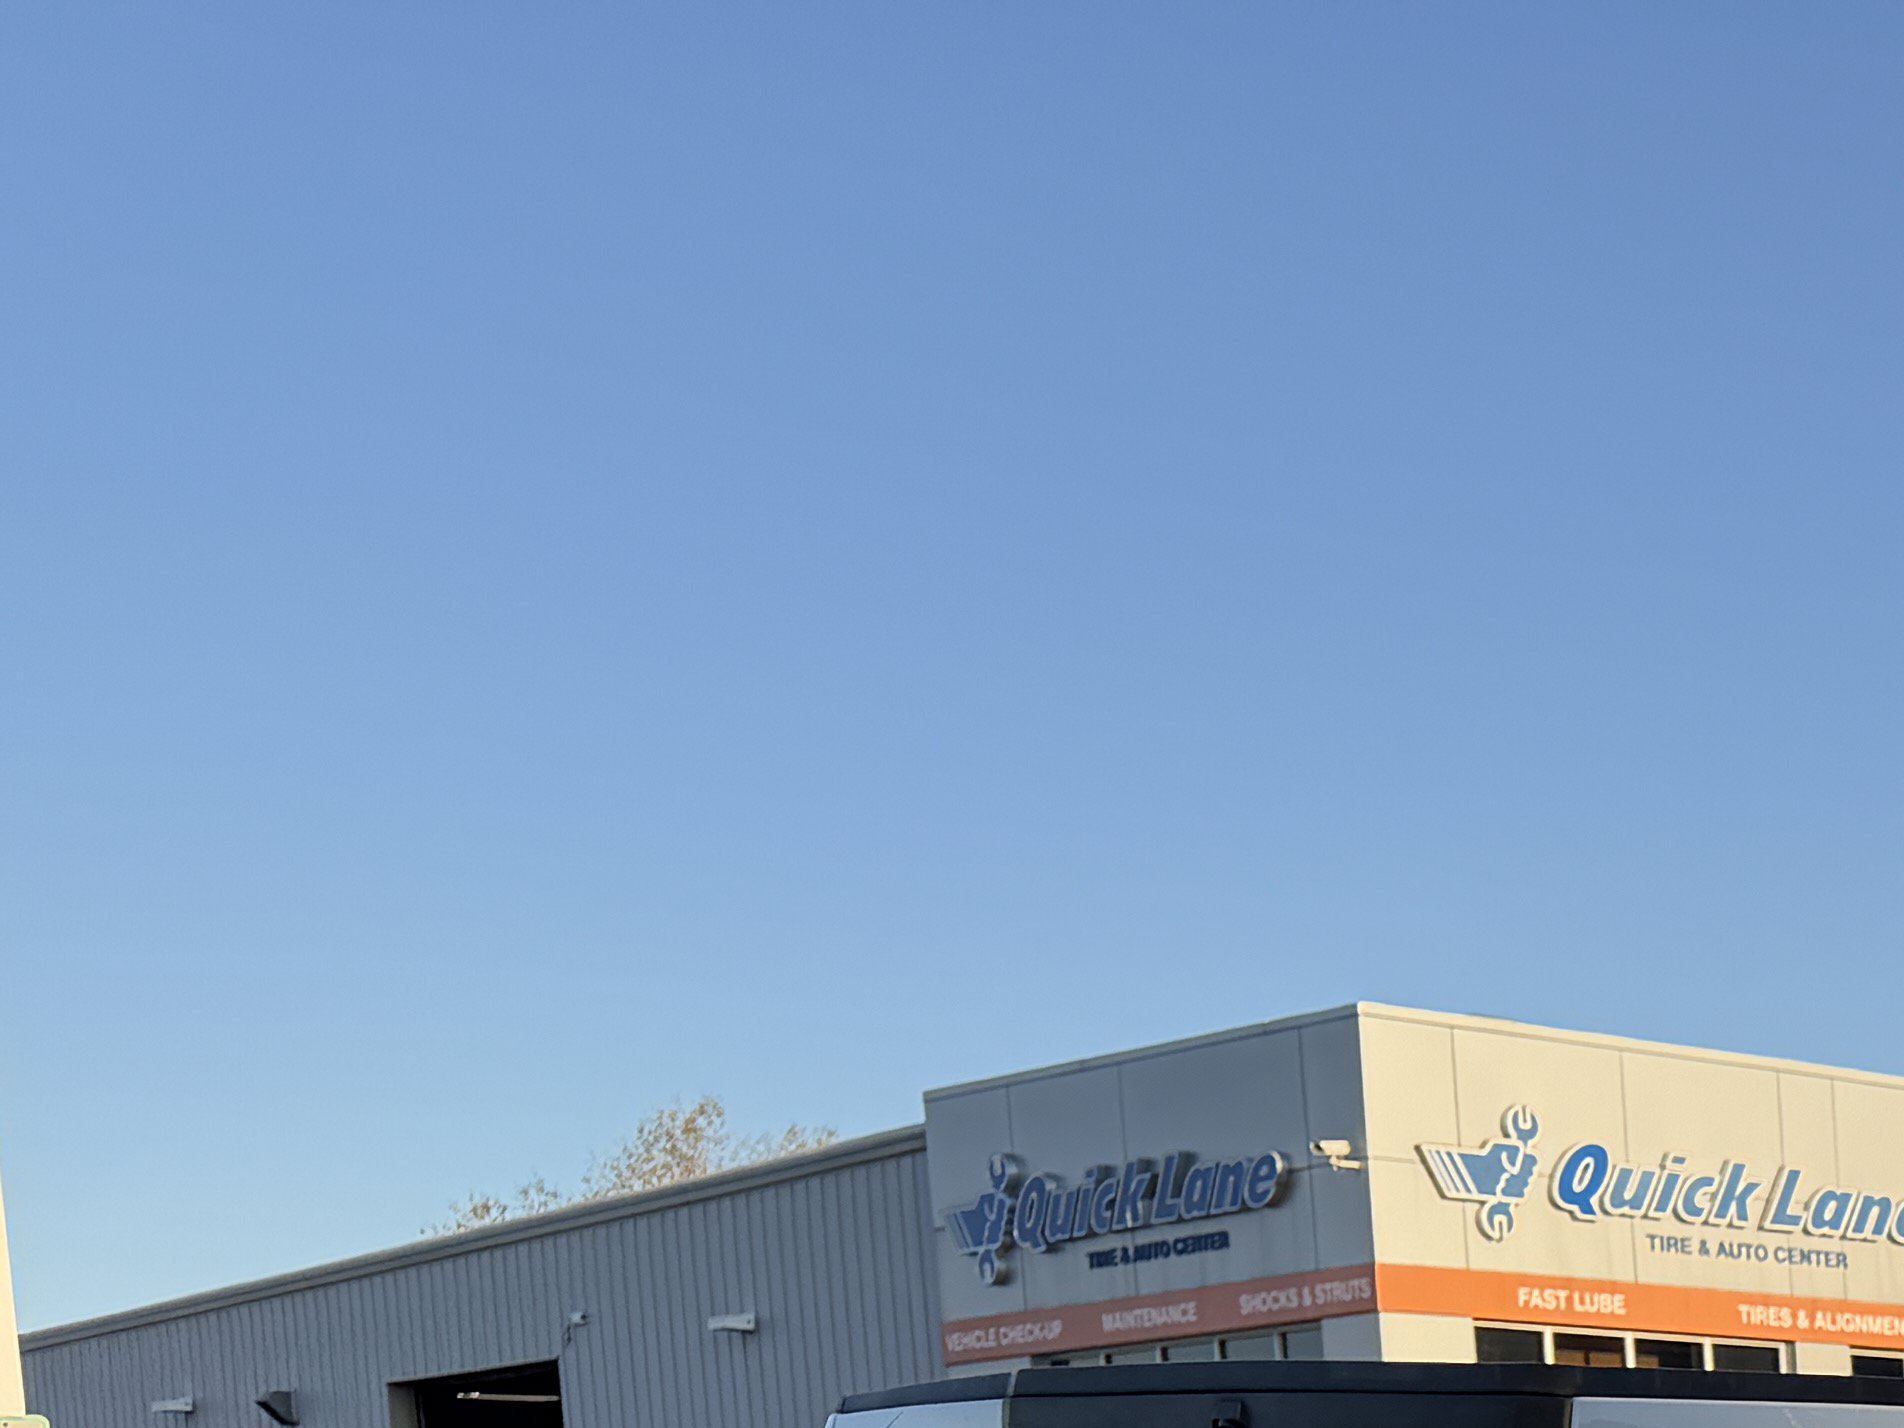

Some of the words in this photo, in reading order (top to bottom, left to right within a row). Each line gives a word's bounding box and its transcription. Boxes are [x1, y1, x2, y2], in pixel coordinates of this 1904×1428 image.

[1014, 1160, 1151, 1252] Quick
[1151, 1150, 1283, 1224] Lane
[1553, 1141, 1762, 1229] Quick
[1645, 1234, 1693, 1256] TIRE
[1699, 1240, 1710, 1257] &
[1716, 1241, 1769, 1263] AUTO
[1774, 1247, 1849, 1271] CENTER
[1239, 1286, 1300, 1316] SHOCKS
[1314, 1277, 1371, 1306] STRUTS
[1517, 1287, 1569, 1312] FAST
[1573, 1291, 1627, 1316] LUBE
[1102, 1301, 1198, 1333] MAINTENANCE
[1738, 1304, 1793, 1328] TIRES
[1798, 1309, 1810, 1330] &
[945, 1327, 998, 1352] VEHICLE
